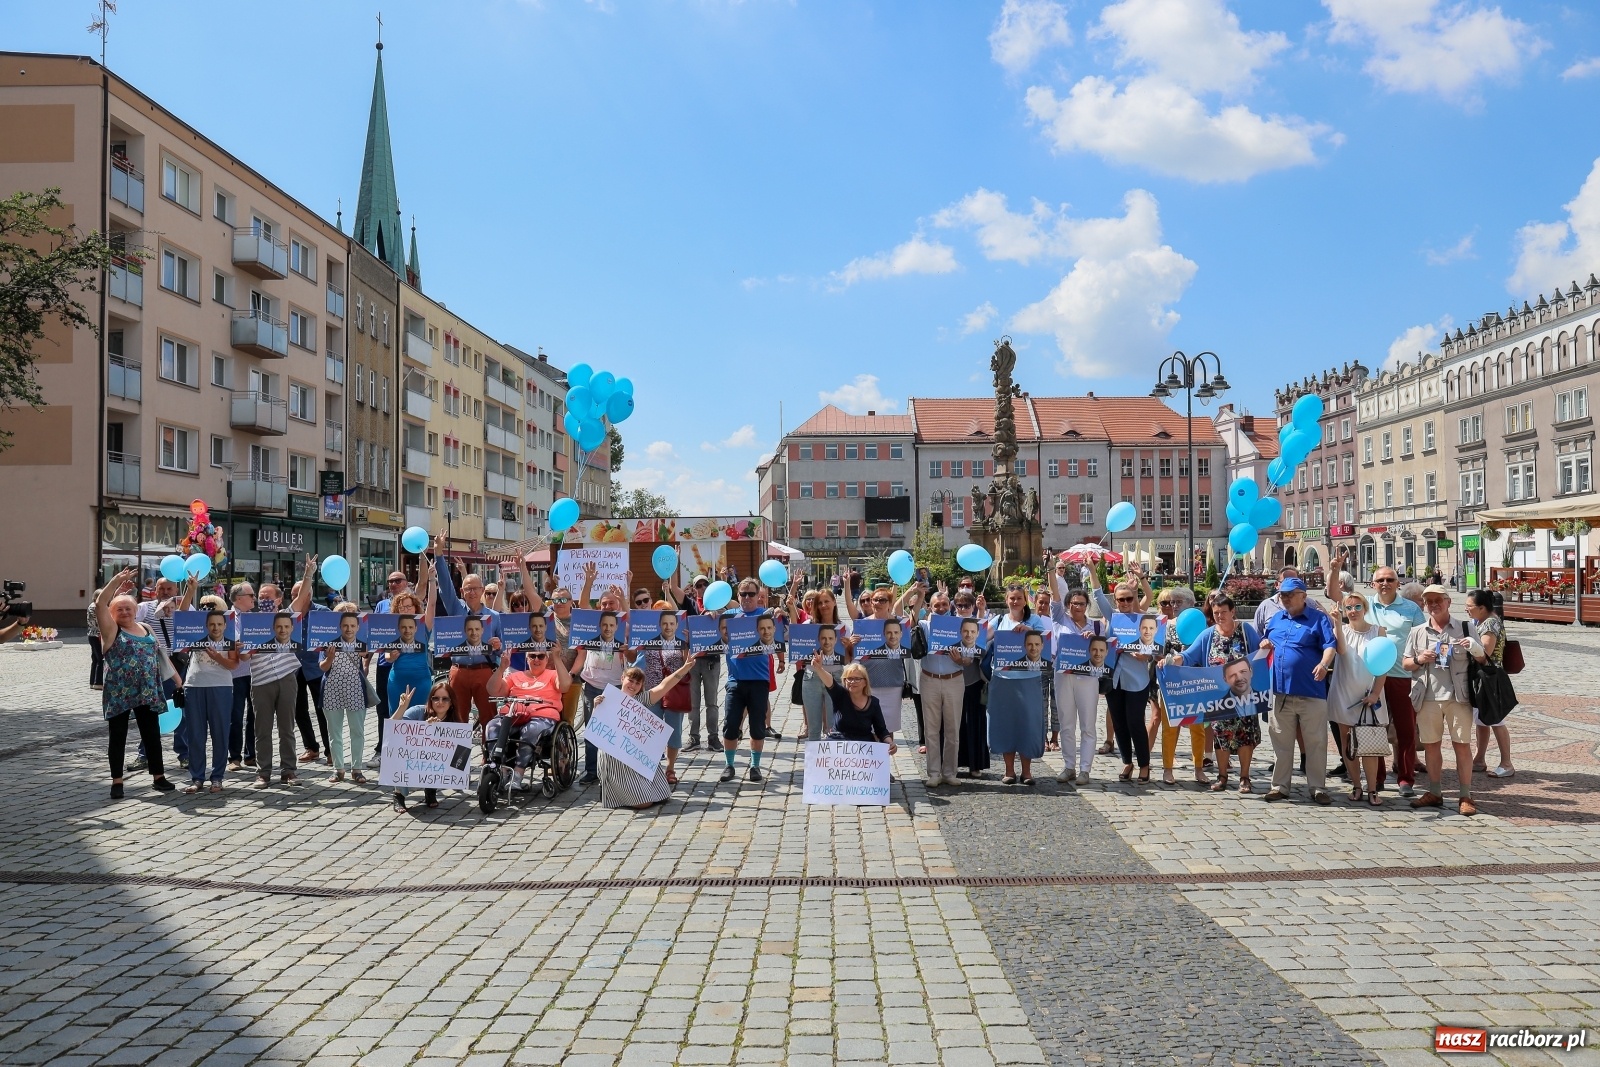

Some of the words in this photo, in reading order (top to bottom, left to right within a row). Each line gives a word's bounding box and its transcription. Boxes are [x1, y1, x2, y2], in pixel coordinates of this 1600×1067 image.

[104, 514, 172, 546] STELLA
[257, 530, 304, 544] JUBILER
[437, 645, 488, 653] TRZASKOWSKI
[572, 639, 620, 648] TRZASKOWSKI
[732, 643, 781, 654] TRZASKOWSKI
[1060, 663, 1110, 674] TRZASKOWSKI
[1165, 681, 1180, 689] Silny
[1182, 678, 1216, 686] Prezydent
[1167, 688, 1195, 696] Wspólna
[620, 696, 664, 733] LEKARSTWEM
[617, 708, 629, 720] NA
[631, 716, 656, 738] NASZE
[394, 722, 432, 736] KONIEC
[434, 726, 472, 738] MARNEGO
[588, 716, 616, 745] RAFAŁ
[617, 718, 648, 744] TROSKI
[386, 747, 394, 758] W
[398, 747, 448, 762] RACIBORZU
[818, 742, 831, 754] NA
[836, 742, 873, 755] FILOKA
[816, 756, 830, 767] NIE
[834, 757, 884, 769] GŁOSUJEMY
[828, 768, 874, 781] RAFAŁOWI
[812, 785, 843, 795] DOBRZE
